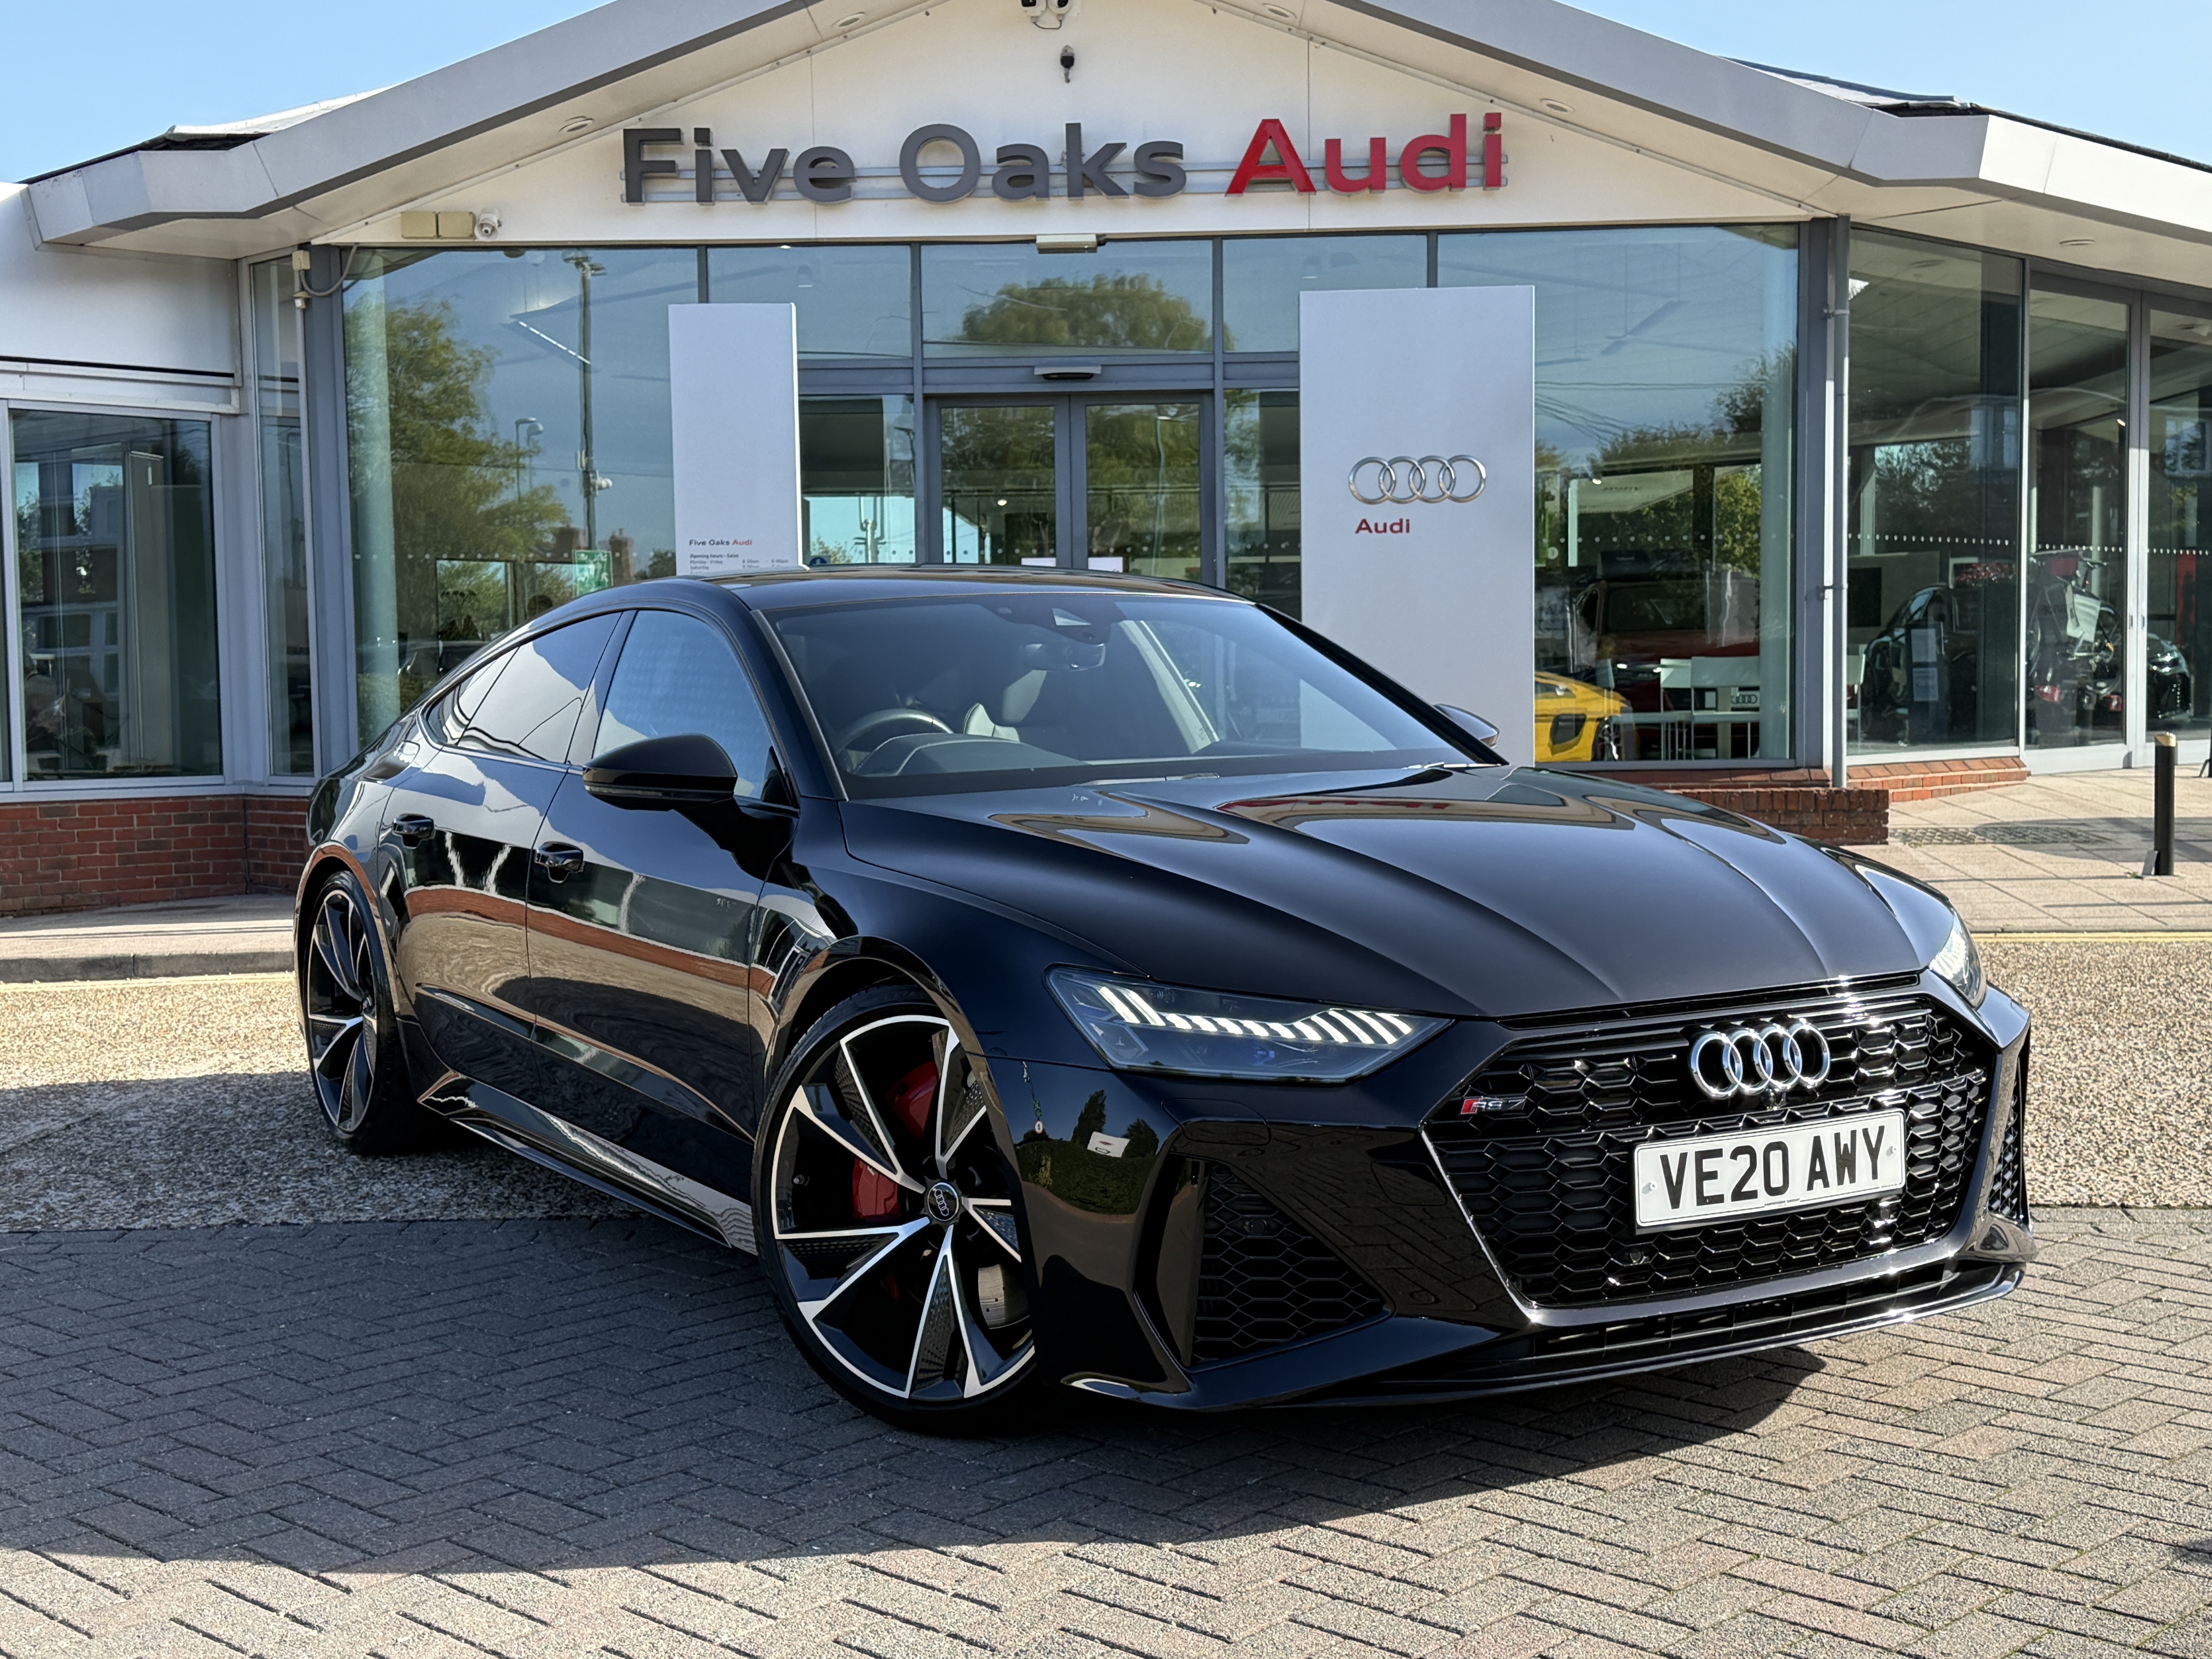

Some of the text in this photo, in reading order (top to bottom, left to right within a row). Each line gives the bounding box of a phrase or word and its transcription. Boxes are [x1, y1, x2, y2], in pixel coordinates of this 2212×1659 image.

[623, 112, 1502, 205] Five Oaks Audi
[1355, 518, 1410, 534] Audi
[1659, 1125, 1885, 1210] VE20 AWY
